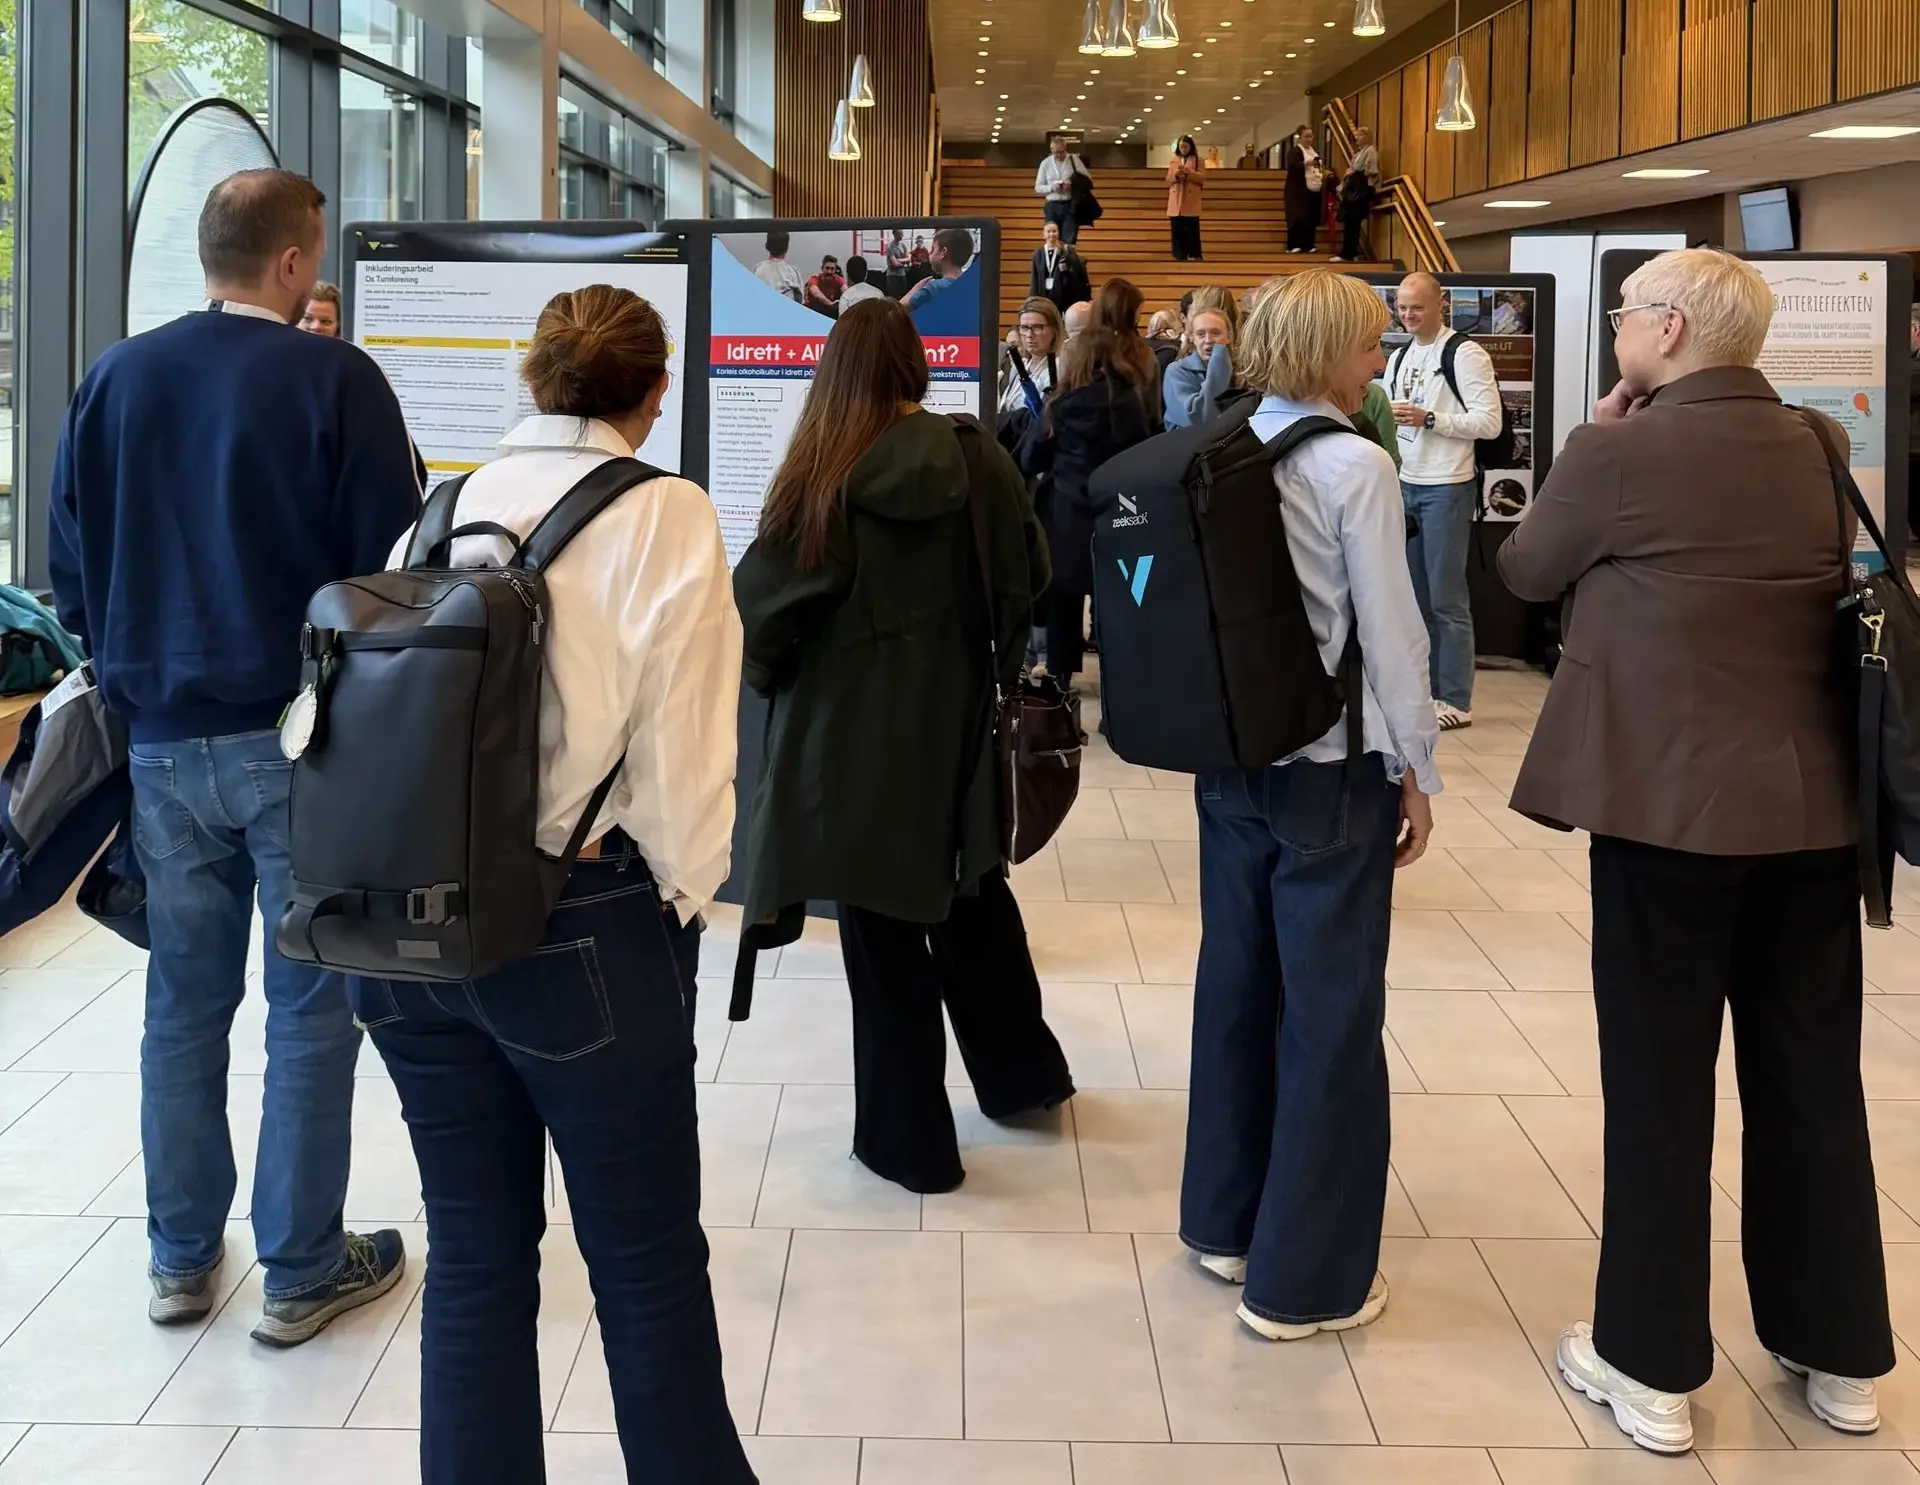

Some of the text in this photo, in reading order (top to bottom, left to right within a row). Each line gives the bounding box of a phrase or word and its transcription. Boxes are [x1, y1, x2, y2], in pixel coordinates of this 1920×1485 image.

[365, 264, 434, 274] Inkluderingsarbeid
[377, 275, 419, 285] Turnforening
[727, 342, 782, 361] Idrett
[716, 368, 738, 376] Korleis
[738, 368, 781, 377] alkoholkultur
[785, 368, 803, 377] idrett
[1112, 511, 1149, 528] zeeksack
